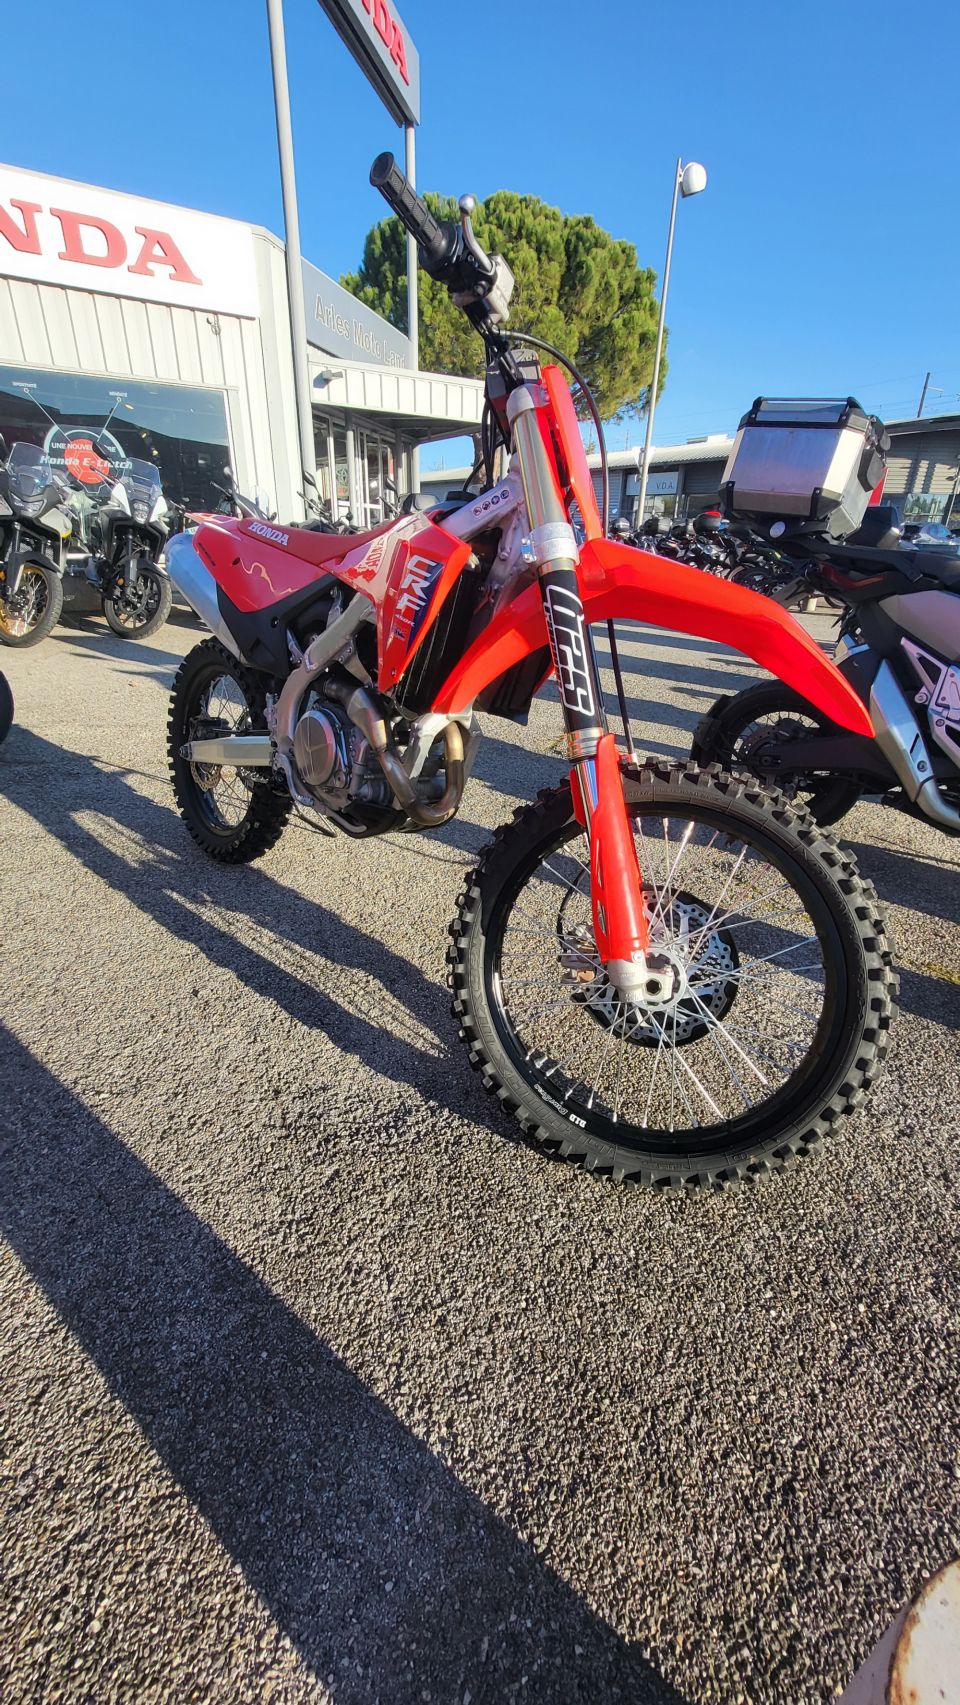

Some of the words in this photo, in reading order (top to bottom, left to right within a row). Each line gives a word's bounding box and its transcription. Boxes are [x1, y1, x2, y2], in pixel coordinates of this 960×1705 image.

[362, 0, 409, 86] DA
[315, 293, 350, 340] Arles
[353, 319, 381, 358] Moto
[40, 455, 80, 466] Honda
[51, 442, 66, 450] UNE
[248, 521, 290, 546] HONDA
[397, 554, 438, 612] CRF
